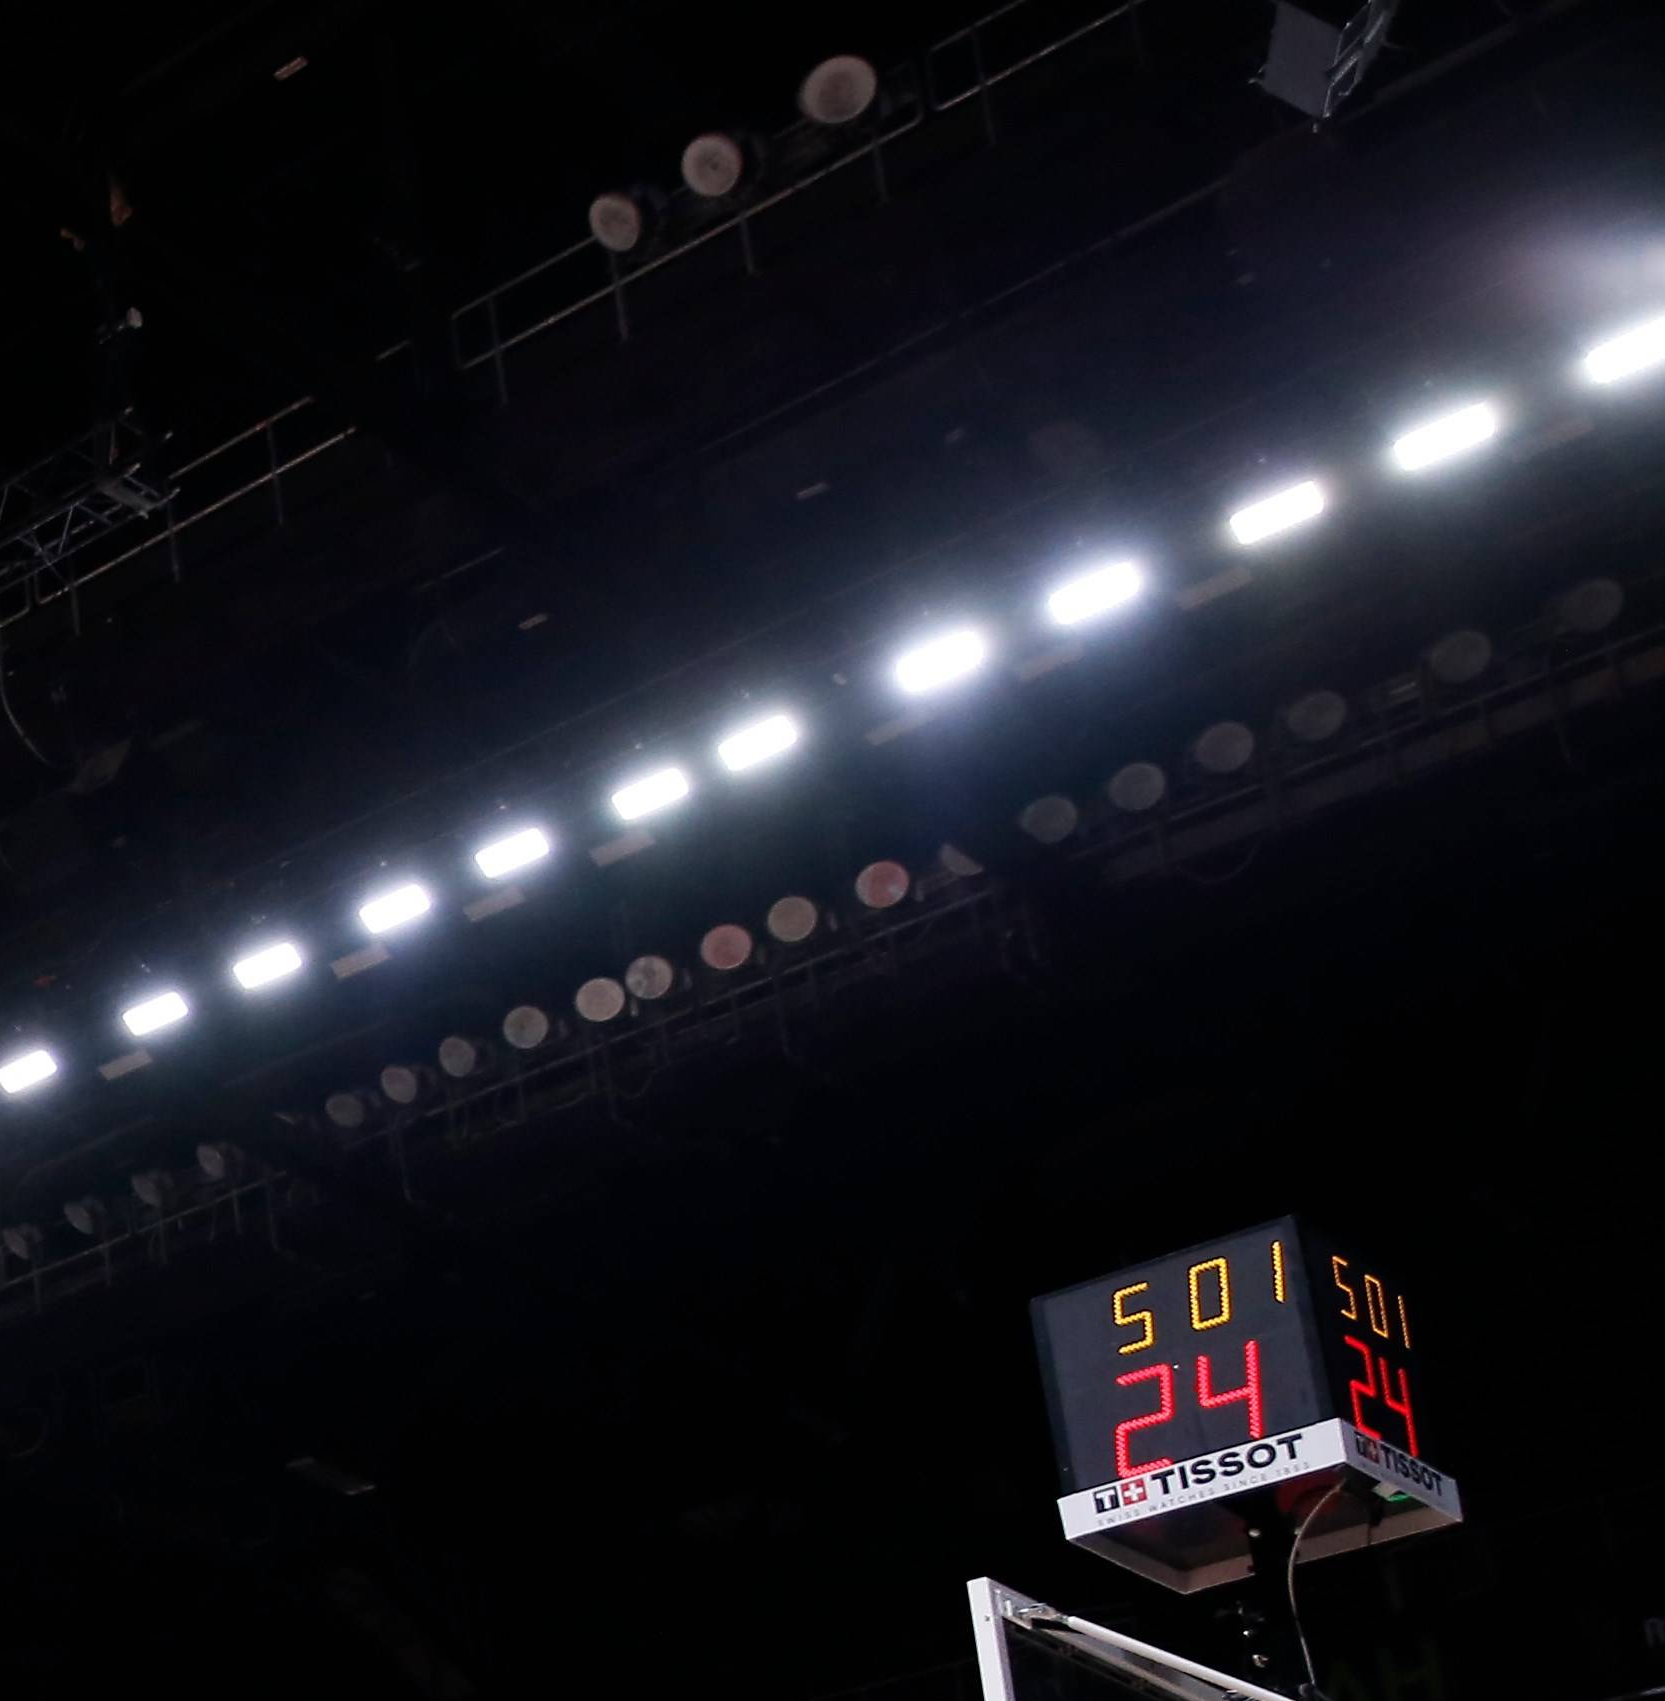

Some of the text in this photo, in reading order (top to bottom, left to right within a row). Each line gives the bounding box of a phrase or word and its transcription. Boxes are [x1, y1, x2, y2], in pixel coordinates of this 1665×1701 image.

[1114, 1339, 1263, 1478] 24
[1344, 1334, 1420, 1458] 24
[1150, 1432, 1304, 1495] TISSOT
[1379, 1443, 1443, 1497] TISSOT
